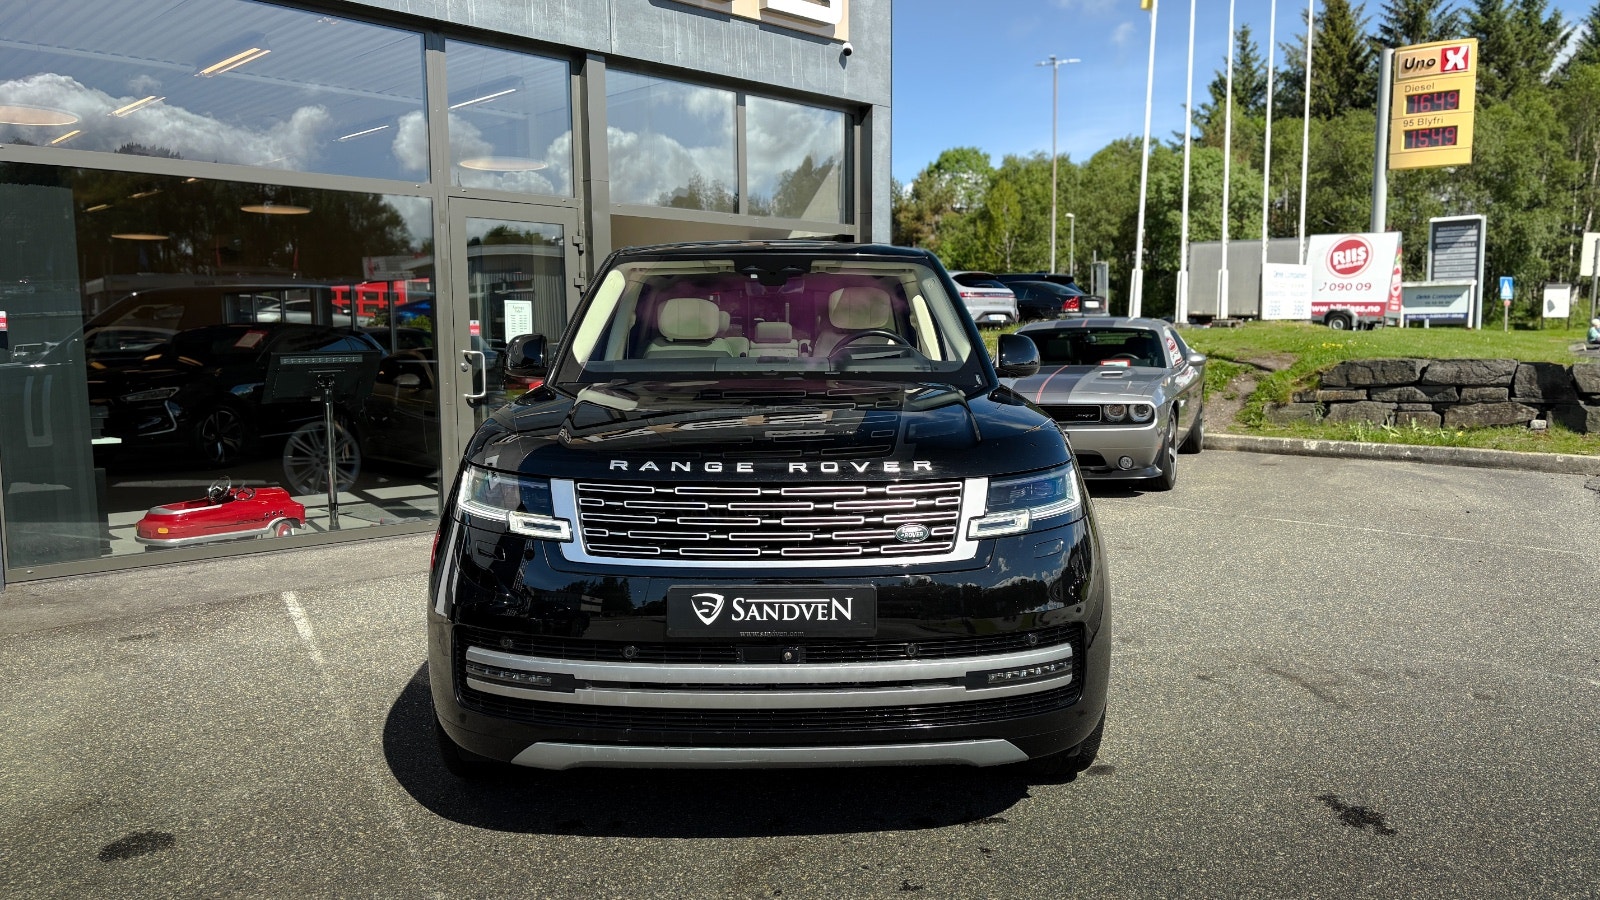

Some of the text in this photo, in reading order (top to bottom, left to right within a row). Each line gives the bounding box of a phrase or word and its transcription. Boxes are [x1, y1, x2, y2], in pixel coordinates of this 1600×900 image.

[1404, 46, 1468, 71] Uno X
[1404, 83, 1435, 93] Diesel
[1403, 116, 1444, 127] 95 Blyfri
[1333, 246, 1367, 266] RIIS
[1329, 282, 1372, 291] 090 09
[609, 459, 933, 473] RANGE ROVER
[731, 597, 854, 622] SANDVEN
[739, 630, 805, 638] www.sandven.com
